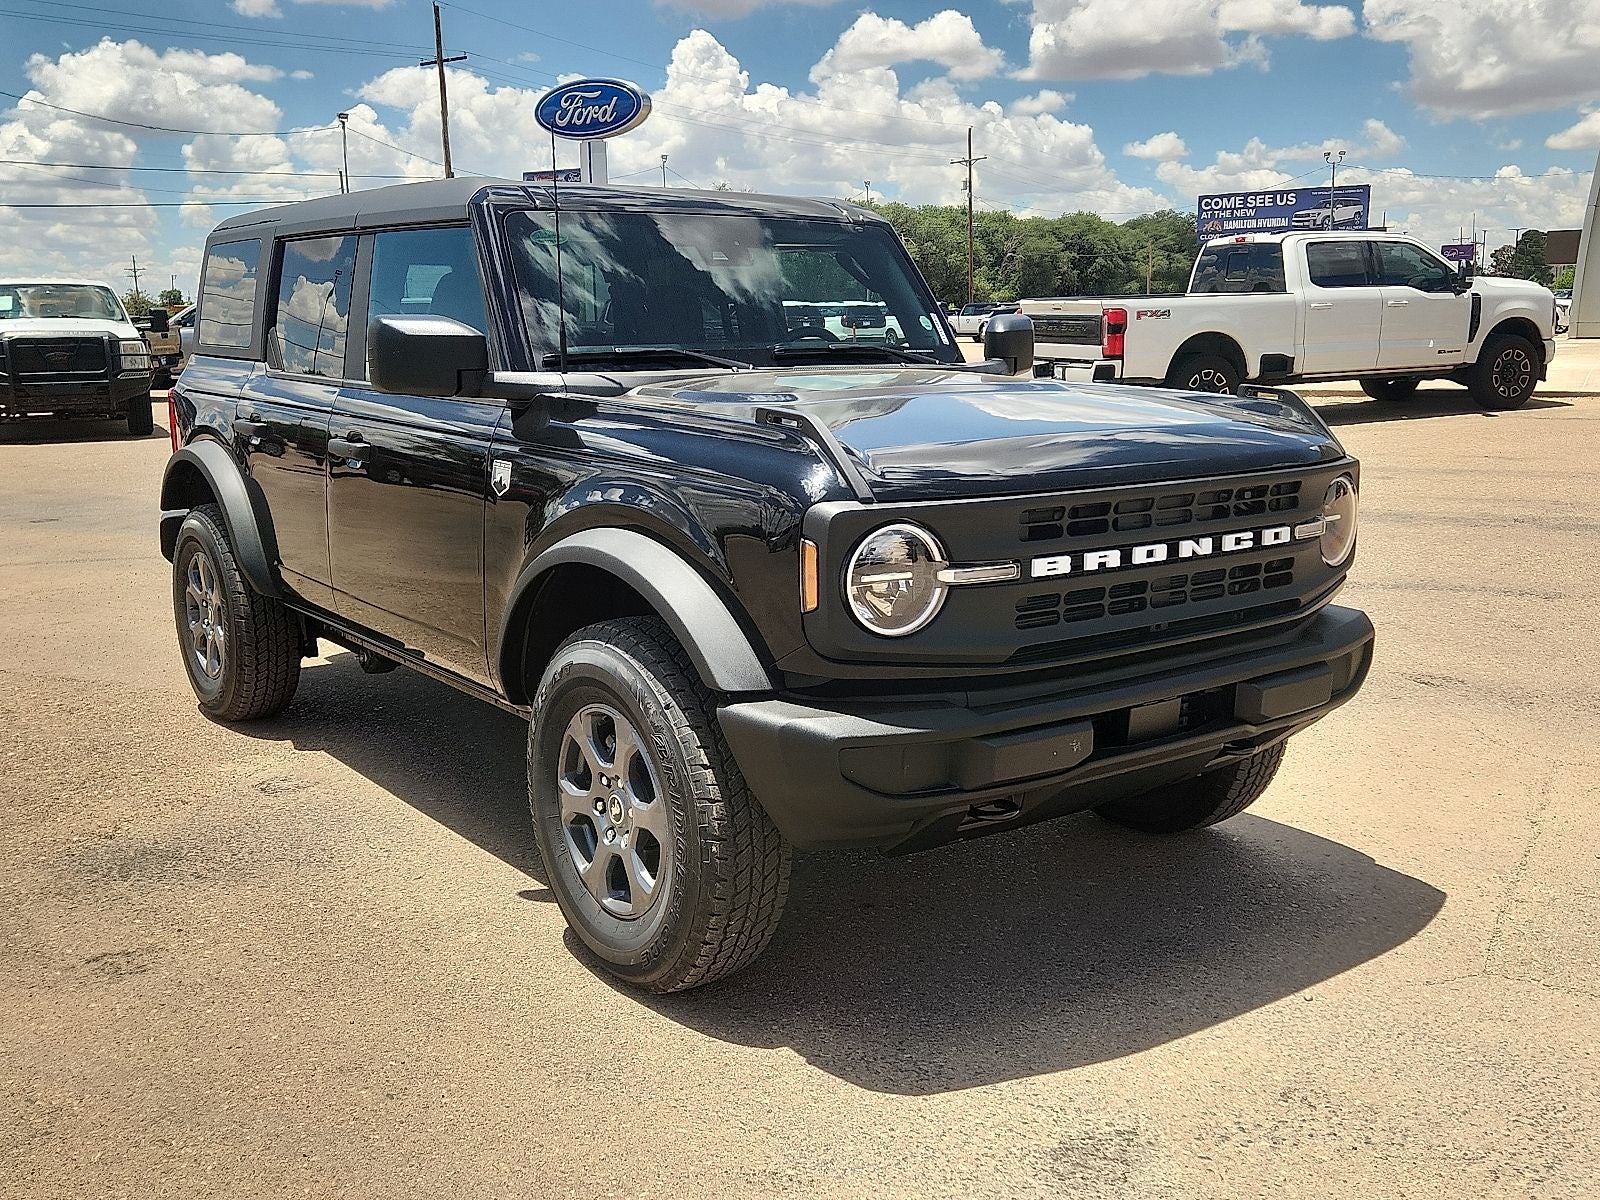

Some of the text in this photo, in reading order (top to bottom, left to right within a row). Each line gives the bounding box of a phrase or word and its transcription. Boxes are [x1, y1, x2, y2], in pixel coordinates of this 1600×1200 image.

[555, 90, 618, 127] Ford
[1201, 193, 1297, 210] COME SEE US
[1200, 208, 1257, 219] AT THE NEW
[1223, 217, 1289, 230] HAMILTON HYUNDAI
[1136, 309, 1171, 320] FX4
[1031, 526, 1291, 578] BRONCO
